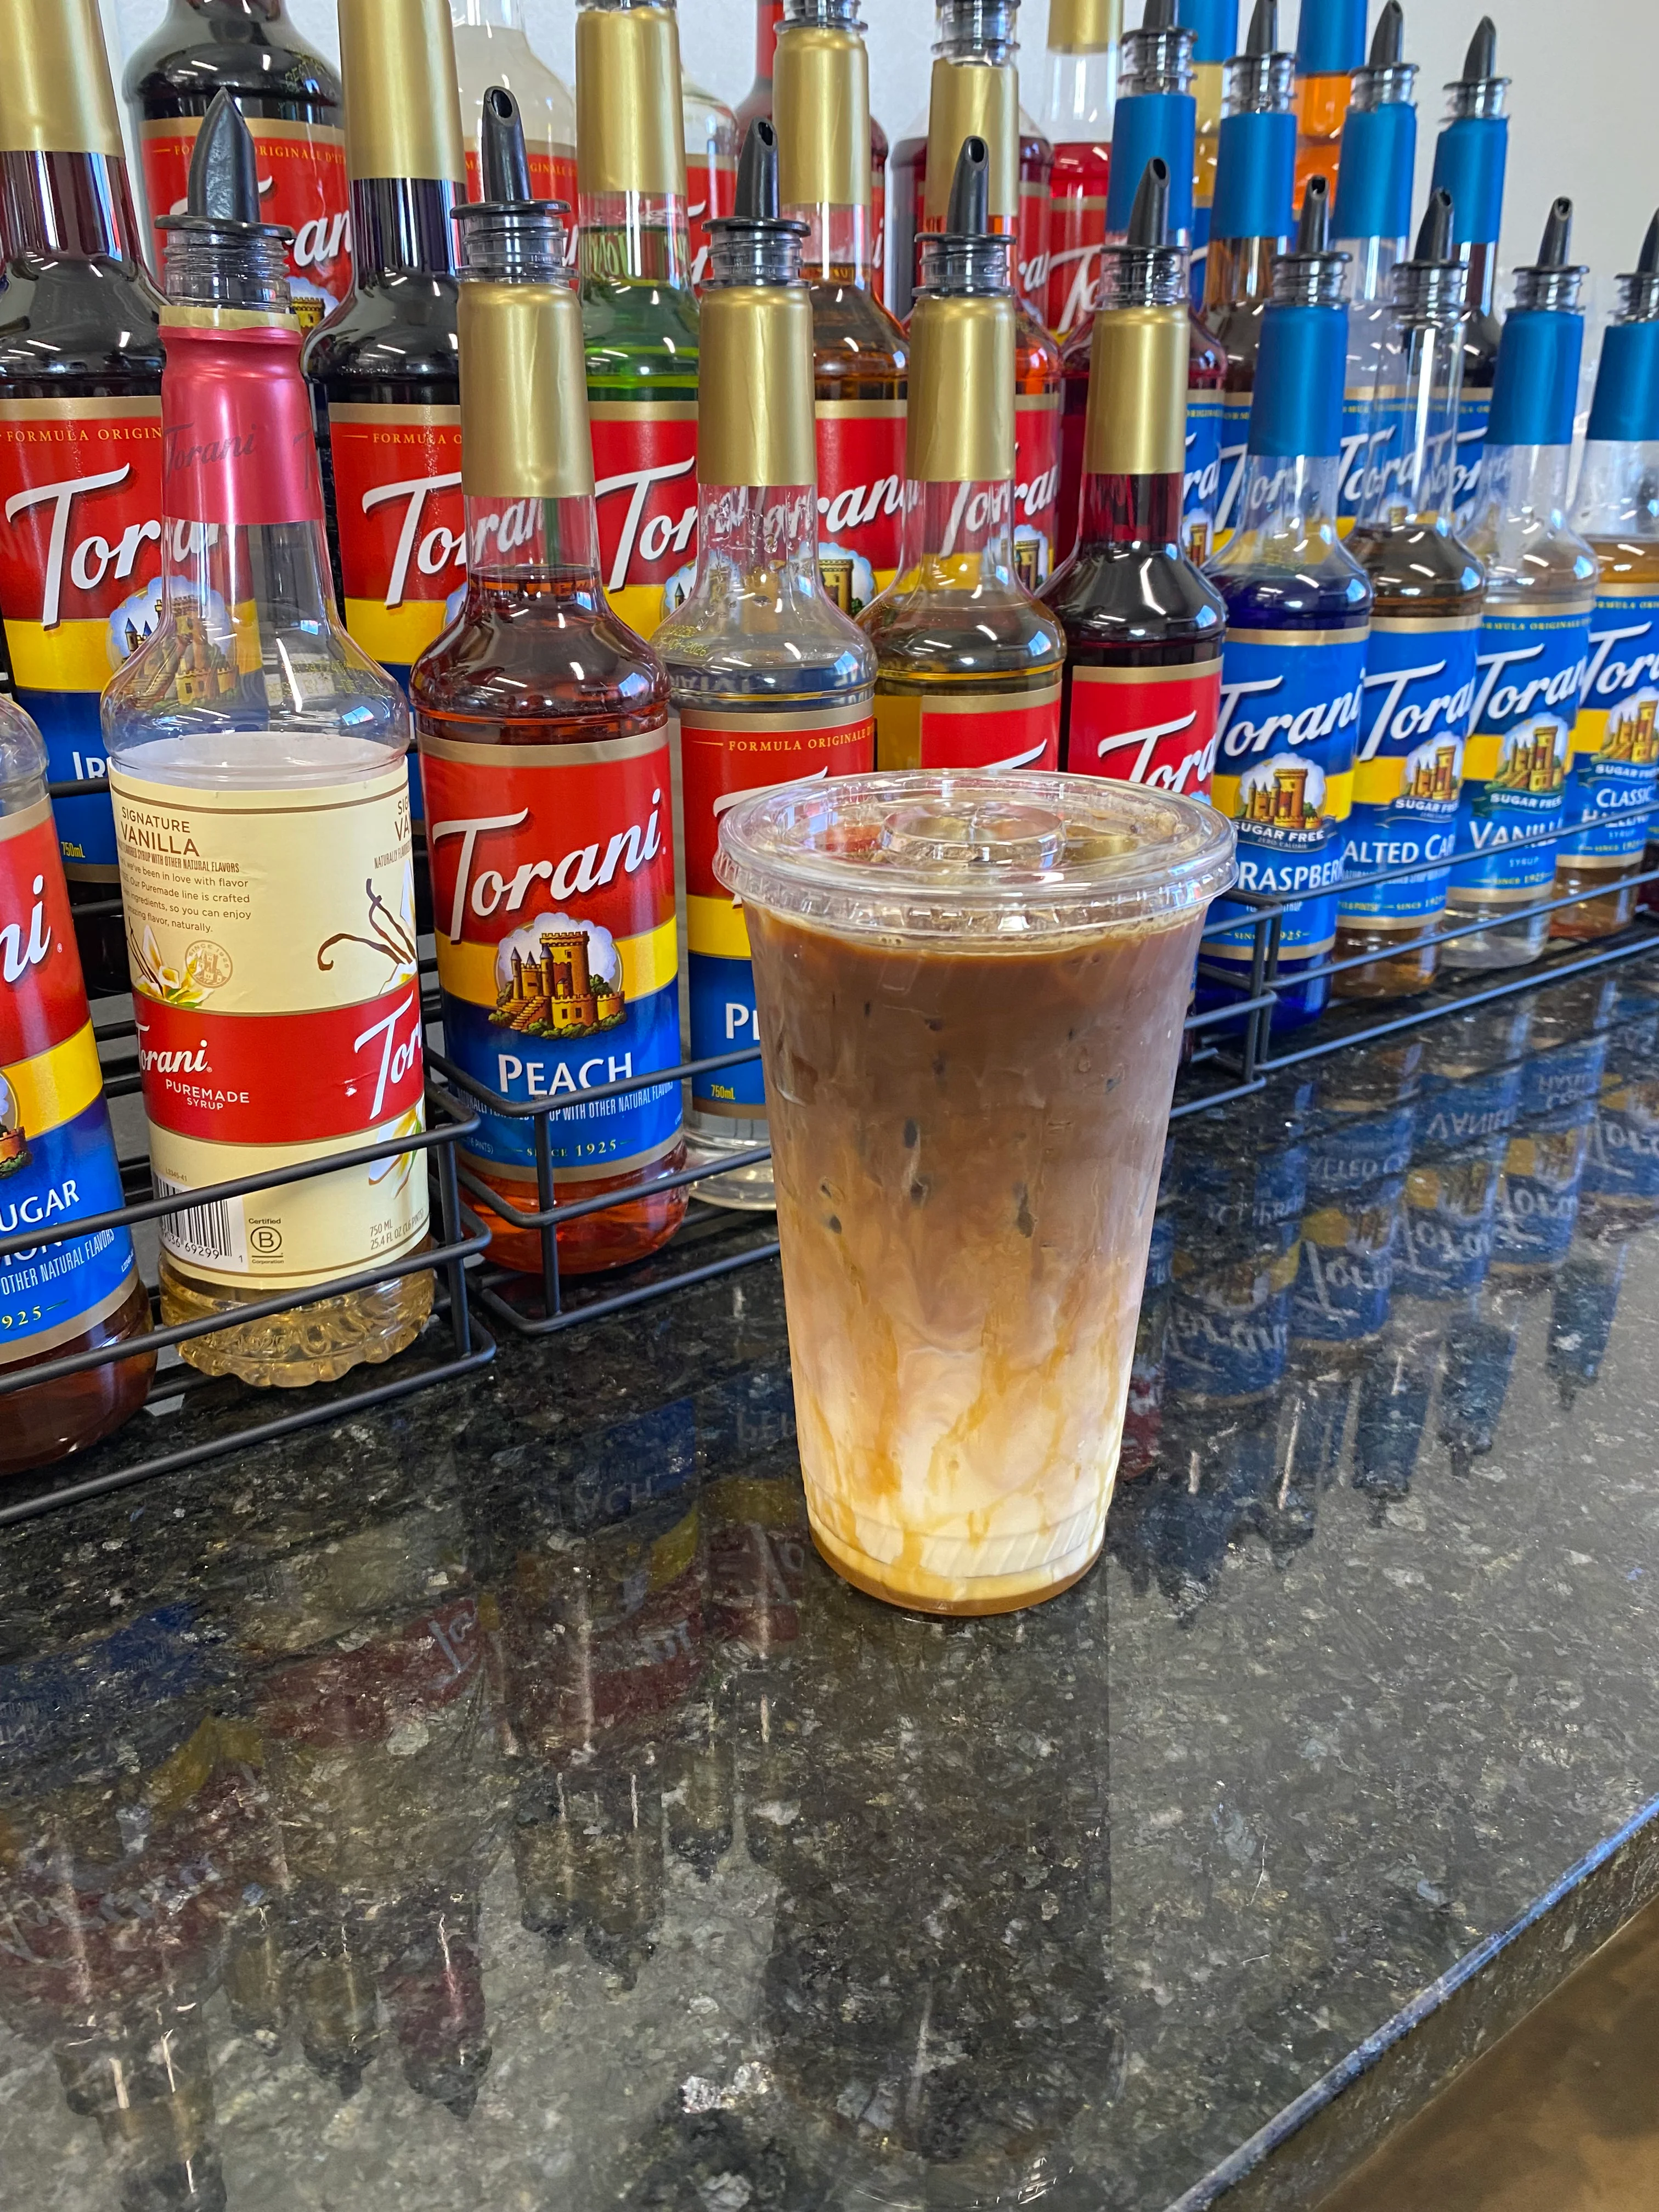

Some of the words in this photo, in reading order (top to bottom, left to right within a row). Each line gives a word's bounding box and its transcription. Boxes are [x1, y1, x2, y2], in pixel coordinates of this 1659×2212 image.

[7, 430, 89, 442] FORMULA
[98, 426, 162, 441] ORIGIN
[373, 432, 446, 444] FORMULA
[165, 420, 258, 484] Torani
[728, 740, 802, 752] FORMULA
[808, 728, 866, 749] ORIGINALE
[1395, 799, 1440, 812] SUGAR
[1491, 793, 1537, 808] SUGAR
[122, 806, 190, 833] SIGNATURE
[121, 821, 200, 857] VANILLA
[1289, 829, 1325, 843] FREE
[61, 842, 86, 858] 750mL
[137, 849, 151, 862] SYRUP
[151, 853, 163, 865] WITH
[165, 856, 182, 868] OTHER
[183, 859, 210, 872] NATURAL
[212, 862, 239, 873] FLAVORS
[1344, 840, 1420, 864] ALTED
[143, 865, 160, 878] been
[162, 871, 170, 881] in
[172, 873, 191, 884] love
[194, 878, 216, 887] with
[219, 878, 249, 888] flavor
[432, 788, 661, 941] Torani
[131, 877, 140, 888] Our
[142, 881, 179, 898] Puremade
[182, 890, 199, 900] line
[202, 892, 209, 901] is
[213, 894, 250, 903] crafted
[148, 912, 170, 927] flavor,
[172, 919, 213, 933] naturally.
[170, 905, 179, 913] so
[182, 907, 199, 916] you
[202, 909, 219, 917] can
[223, 910, 251, 920] enjoy
[354, 990, 421, 1120] Tor
[498, 1052, 633, 1096] PEACH
[165, 1078, 250, 1104] PUREMADE
[710, 1085, 736, 1100] 750mL
[187, 1097, 224, 1111] SYRUP
[563, 1104, 586, 1121] WITH
[589, 1097, 616, 1118] OTHER
[618, 1087, 651, 1113] NATURAL
[575, 1139, 617, 1157] 1925
[0, 1179, 80, 1233] UGAR
[370, 1223, 382, 1237] 750
[384, 1218, 393, 1232] ML
[370, 1235, 385, 1250] 25.4
[386, 1232, 393, 1244] FL
[394, 1226, 402, 1239] OZ
[185, 1242, 219, 1260] 69299
[0, 1267, 38, 1295] OTHER
[40, 1246, 85, 1283] NATURAL
[2, 1305, 42, 1330] 925
